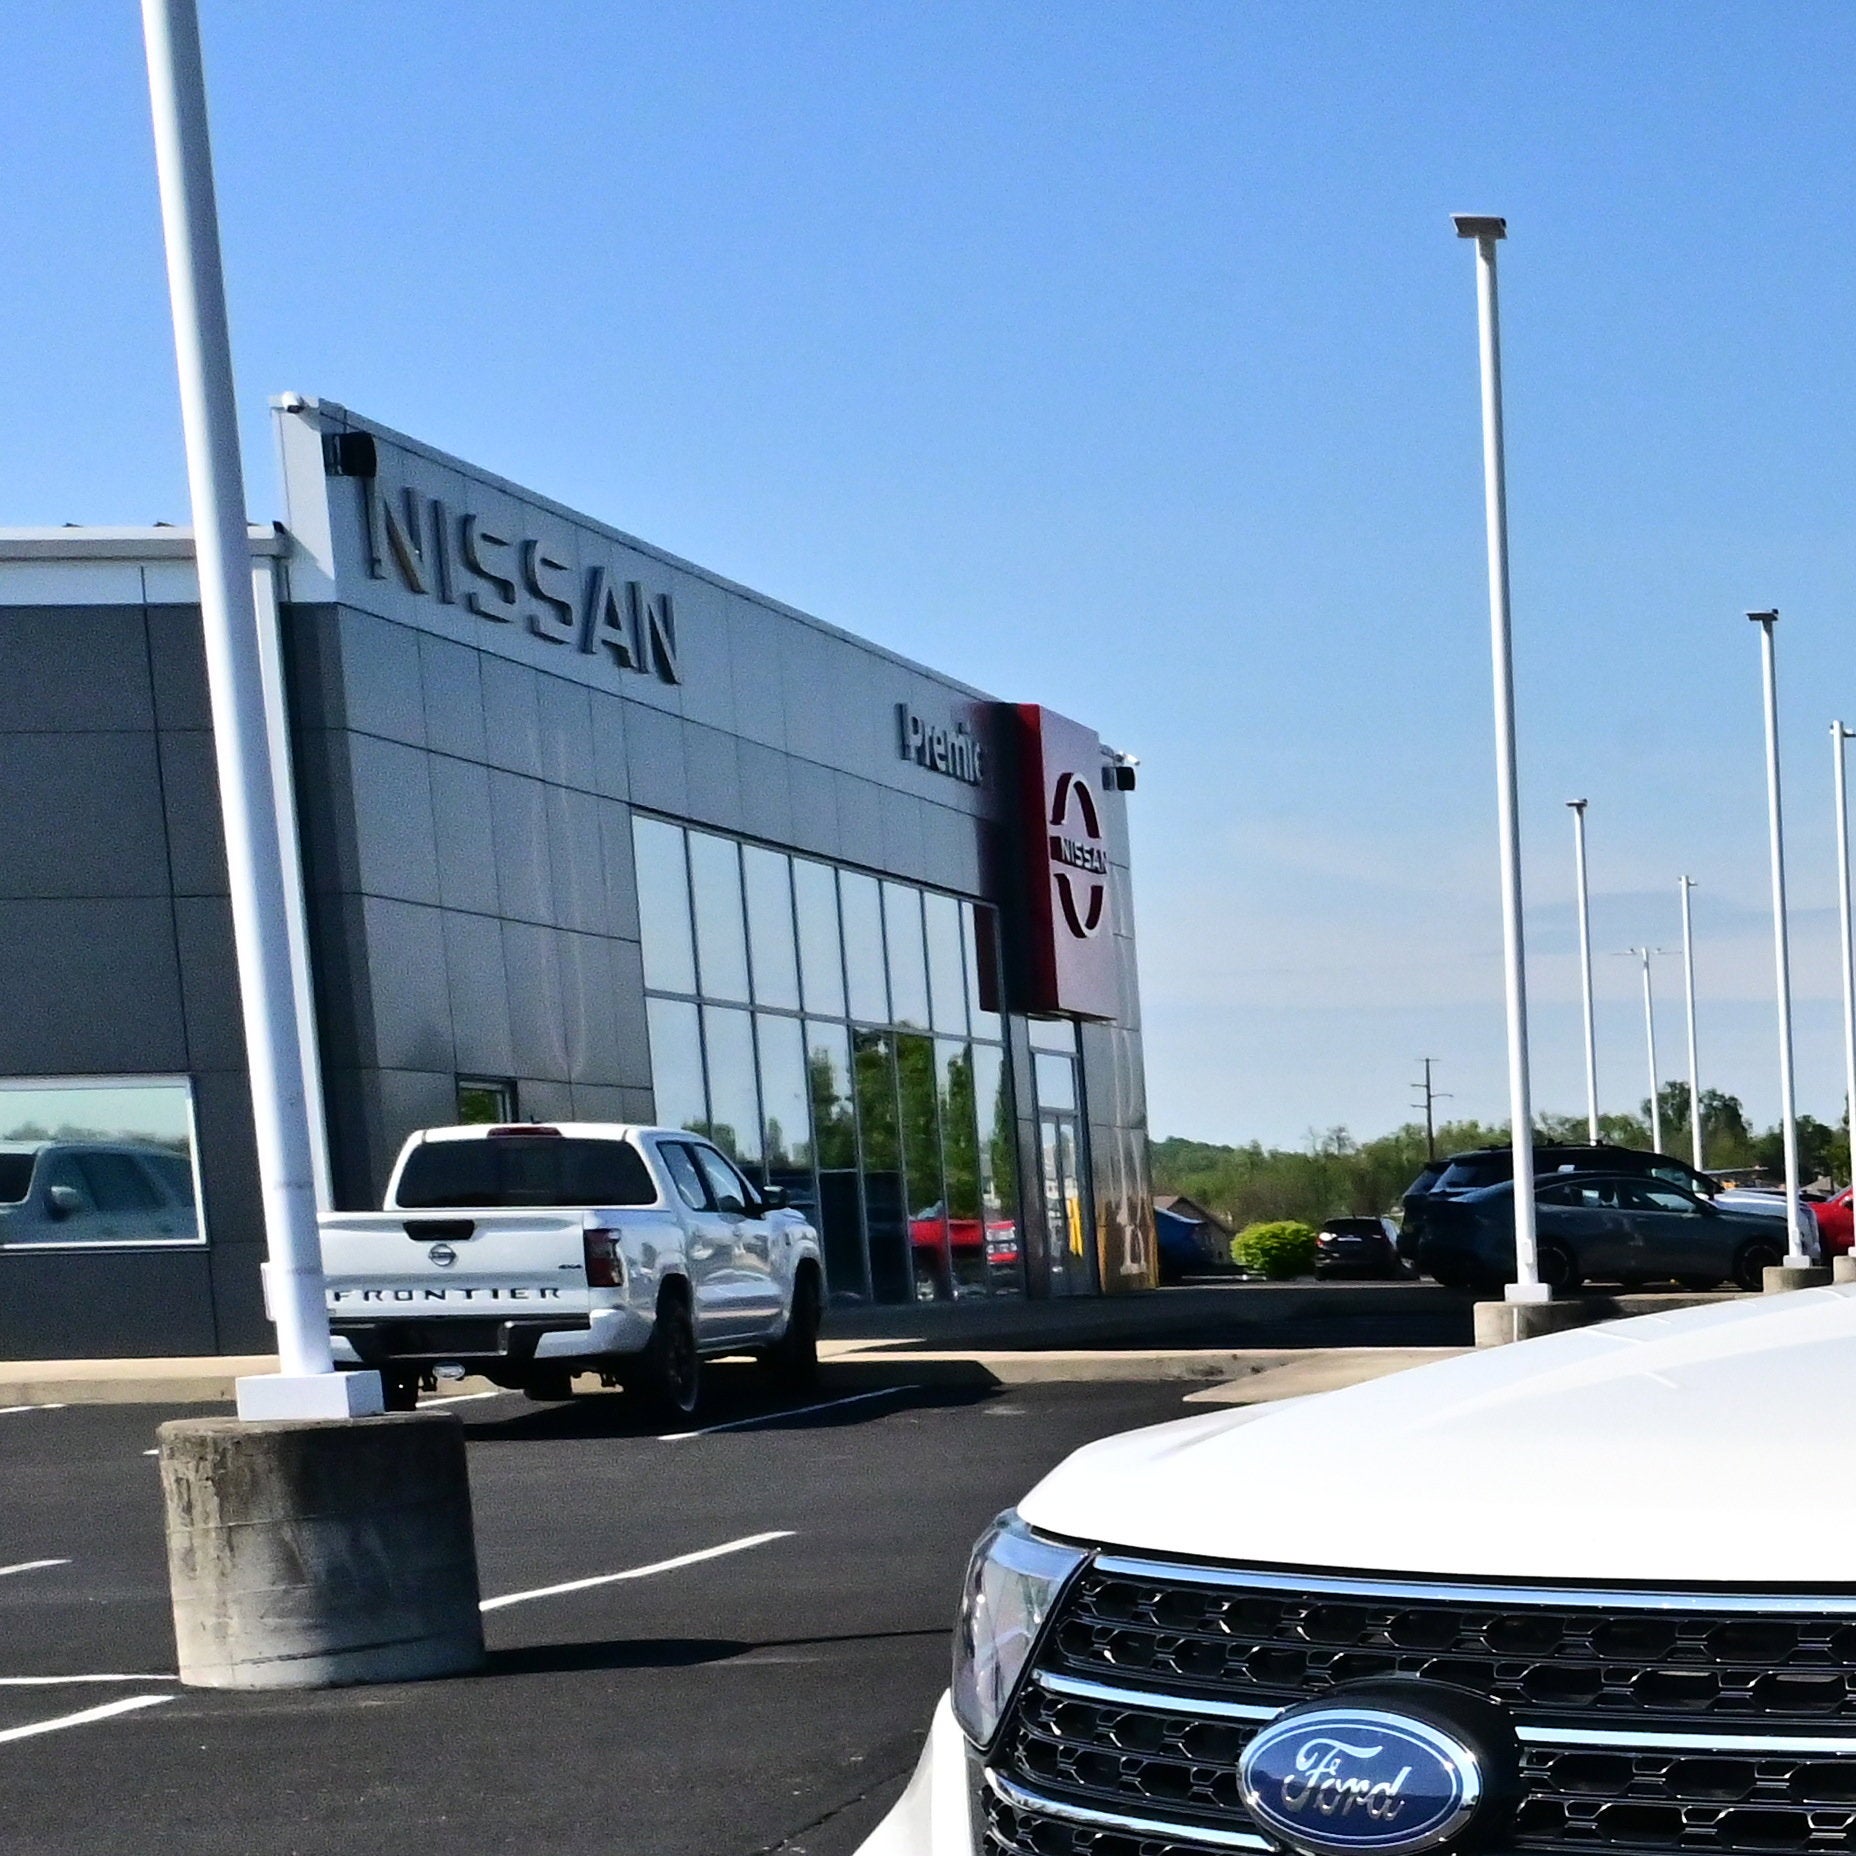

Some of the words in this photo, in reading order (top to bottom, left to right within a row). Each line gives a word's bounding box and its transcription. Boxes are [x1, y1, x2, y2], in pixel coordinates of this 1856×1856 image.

[360, 474, 683, 686] NISSAN
[1060, 836, 1107, 874] NISSAN
[334, 1287, 560, 1303] FRONTIER
[1281, 1737, 1413, 1821] Ford
